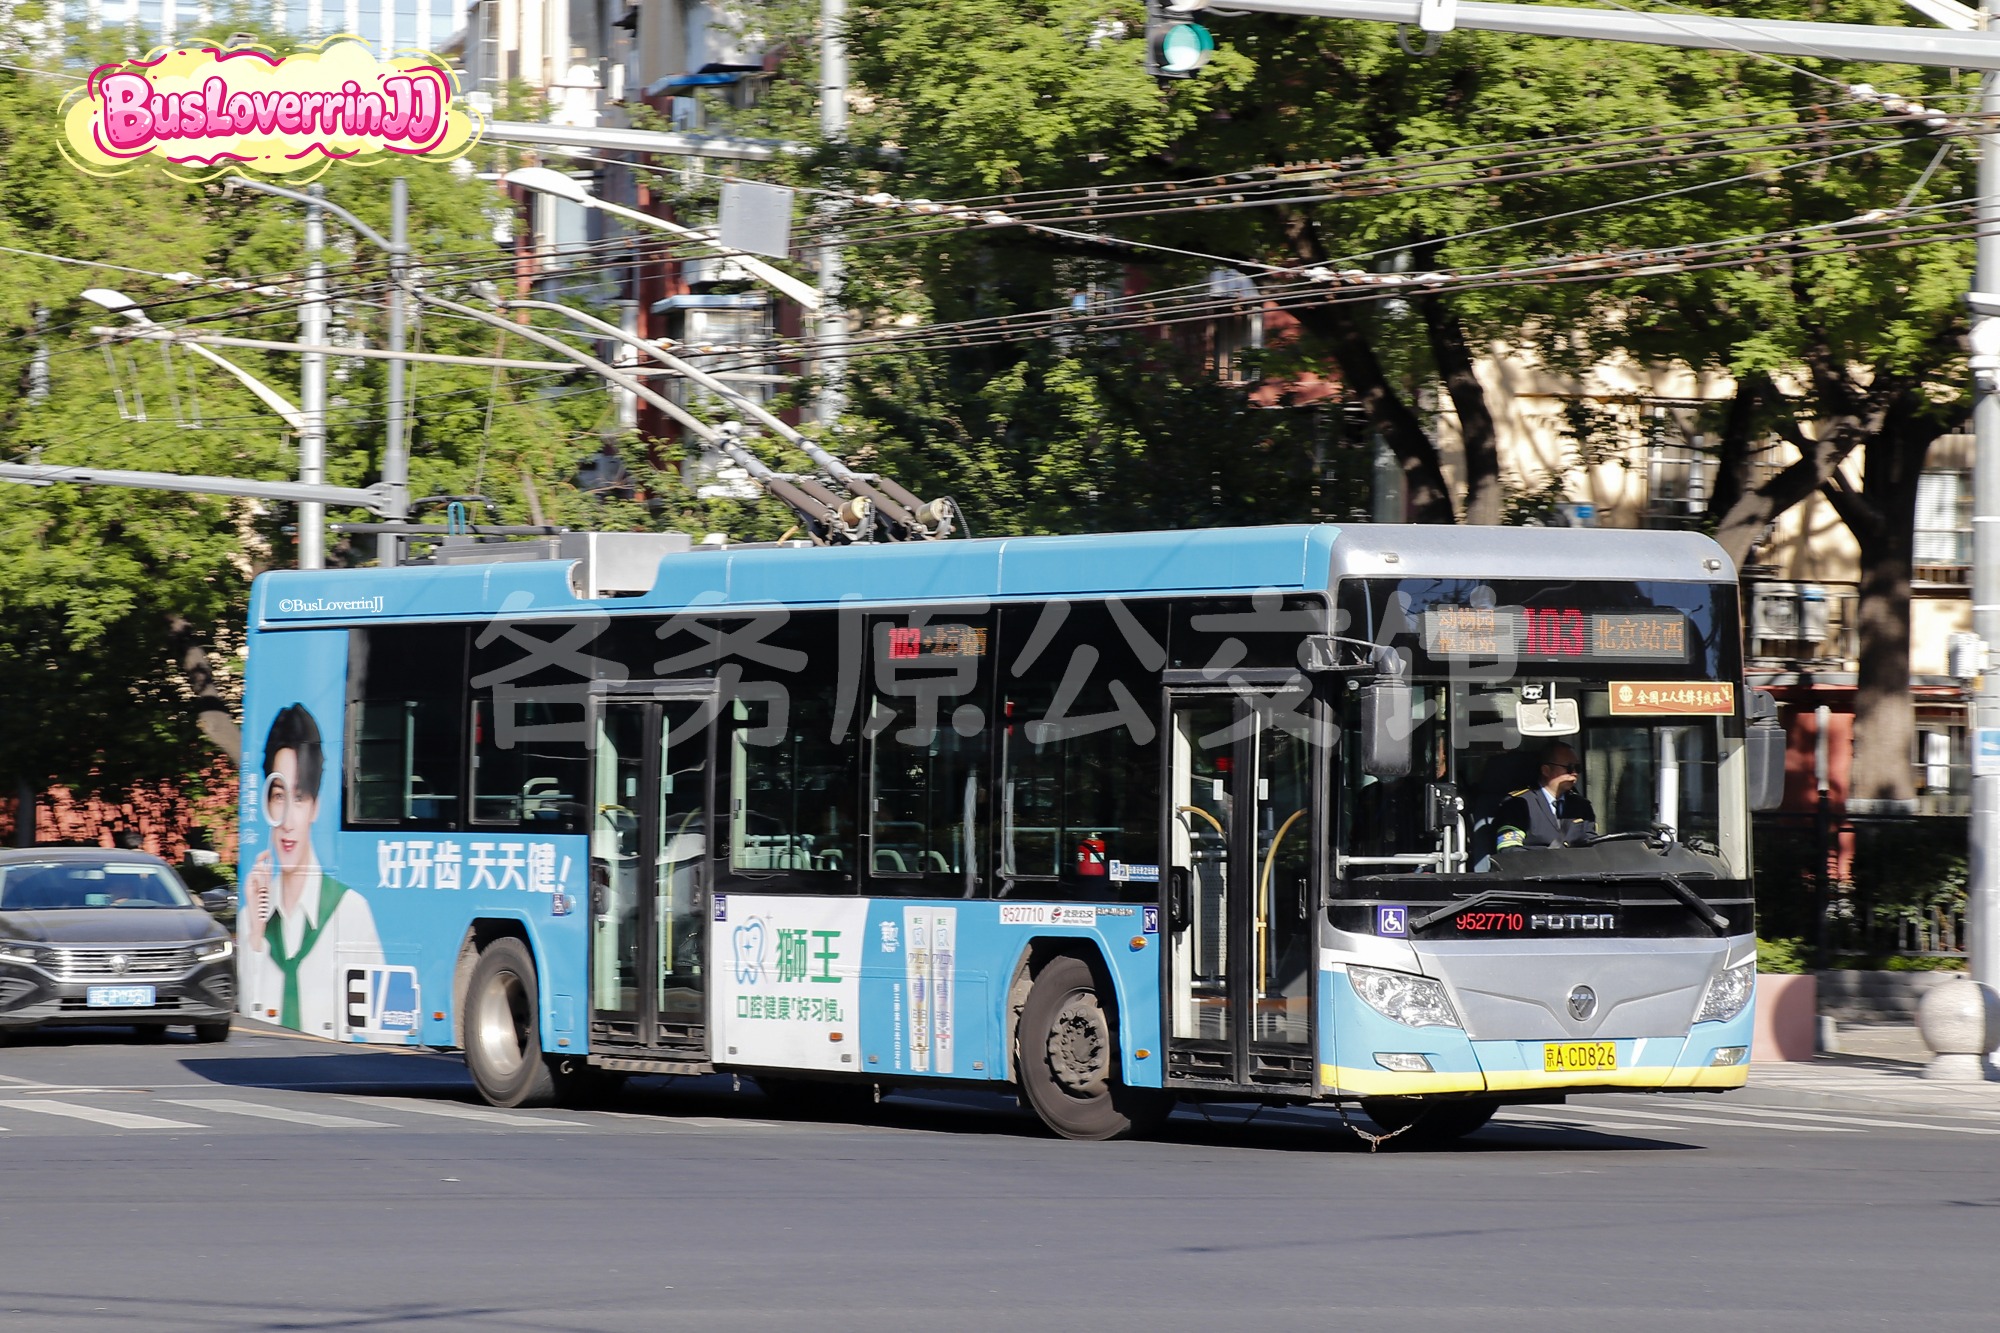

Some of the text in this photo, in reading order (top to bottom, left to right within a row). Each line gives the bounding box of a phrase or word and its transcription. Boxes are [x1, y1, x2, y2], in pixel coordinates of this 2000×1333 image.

[888, 628, 920, 659] 103
[1523, 608, 1584, 655] 103
[1594, 618, 1684, 652] 北京站西
[377, 840, 463, 889] 好牙齿
[1003, 907, 1044, 922] 9527710
[1064, 909, 1094, 919] 北京公交
[1456, 913, 1523, 930] 9527710
[1531, 914, 1614, 930] FOTON
